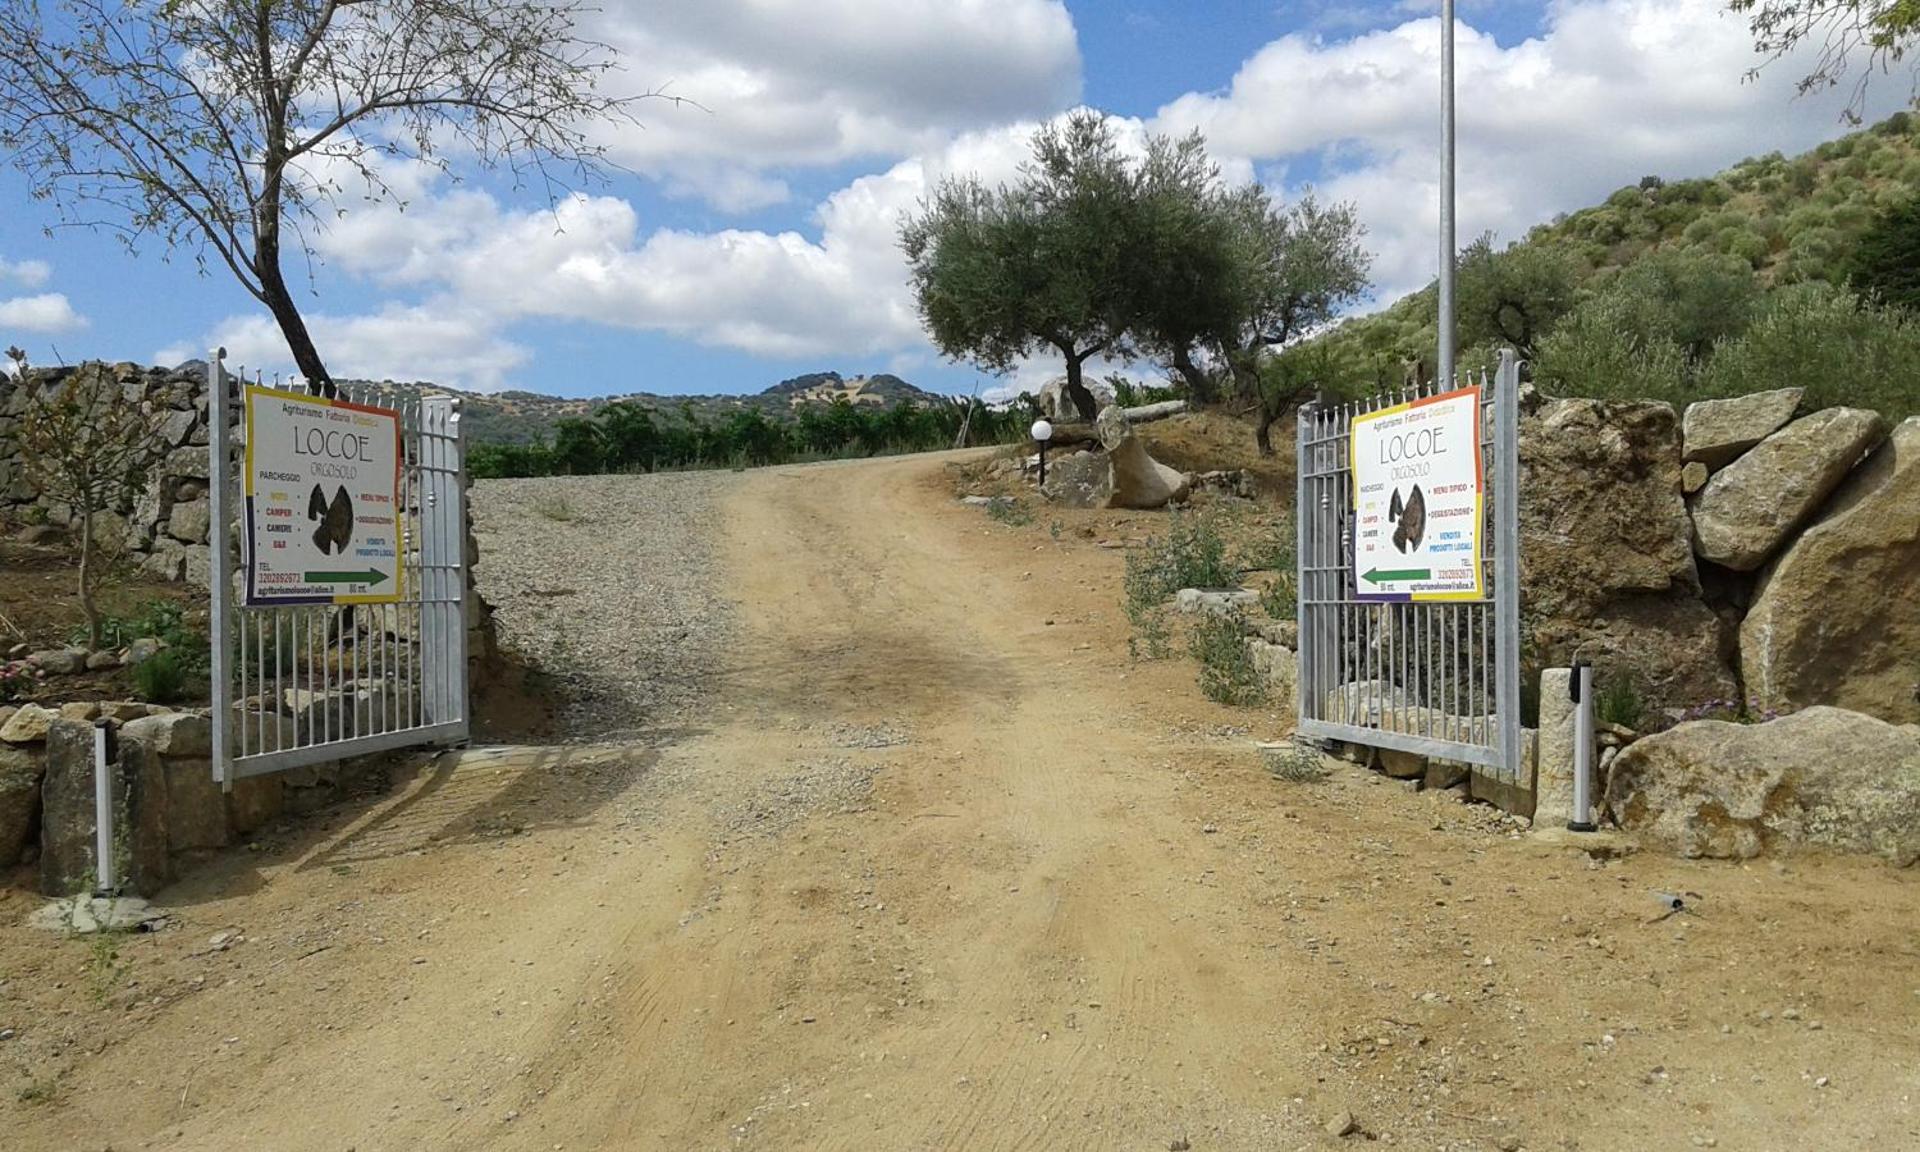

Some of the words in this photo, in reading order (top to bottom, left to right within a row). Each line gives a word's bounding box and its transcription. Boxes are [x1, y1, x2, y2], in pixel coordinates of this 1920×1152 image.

[283, 402, 322, 418] Agriturismo
[294, 425, 373, 462] LOCOE
[1381, 426, 1447, 464] LOCOE
[259, 471, 300, 482] PARCHEGGIO
[311, 462, 357, 480] ORGOSOLO
[1433, 486, 1448, 495] MENU
[266, 508, 292, 516] CAMPER
[1431, 507, 1470, 518] DEGUSTAZIONE
[267, 524, 292, 532] CAMERE
